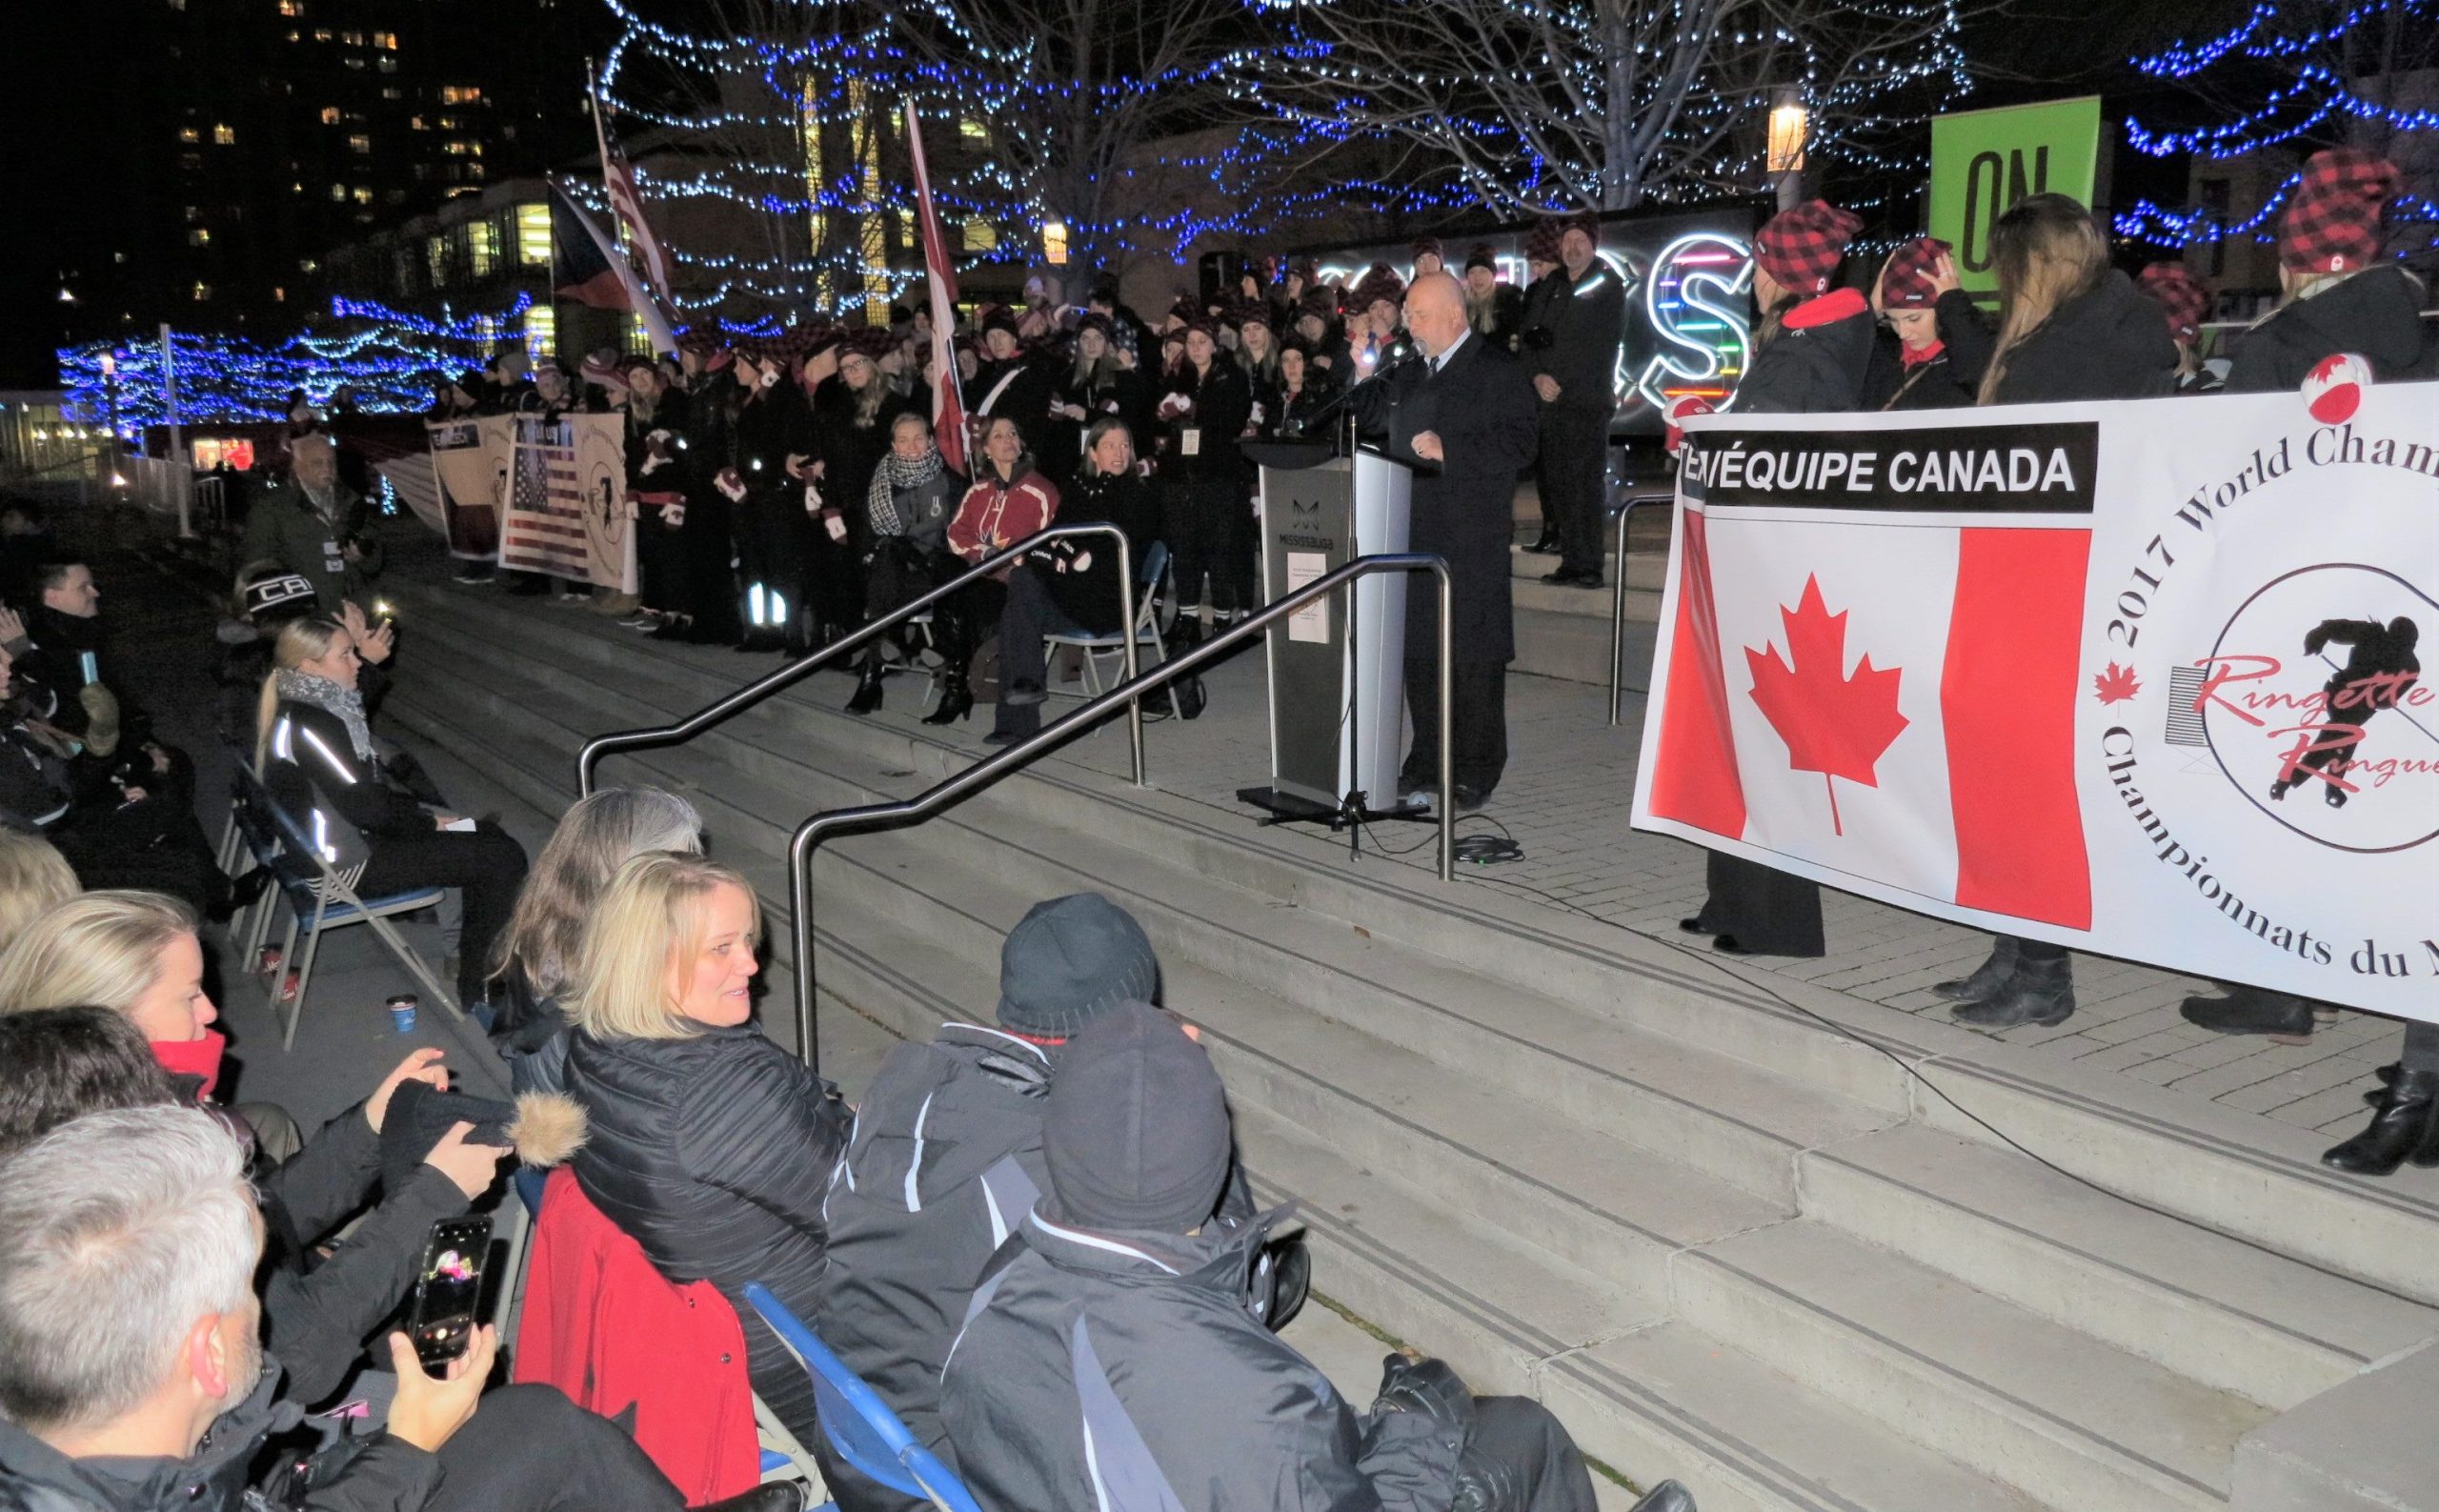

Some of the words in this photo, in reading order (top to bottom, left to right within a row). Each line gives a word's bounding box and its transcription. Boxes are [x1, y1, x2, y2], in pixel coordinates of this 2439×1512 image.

[1888, 448, 2076, 493] CANADA
[2107, 534, 2175, 649] 2017
[2173, 436, 2293, 533] World
[2192, 655, 2436, 727] Ringette
[2102, 726, 2332, 966] Championnats
[2349, 938, 2411, 978] du
